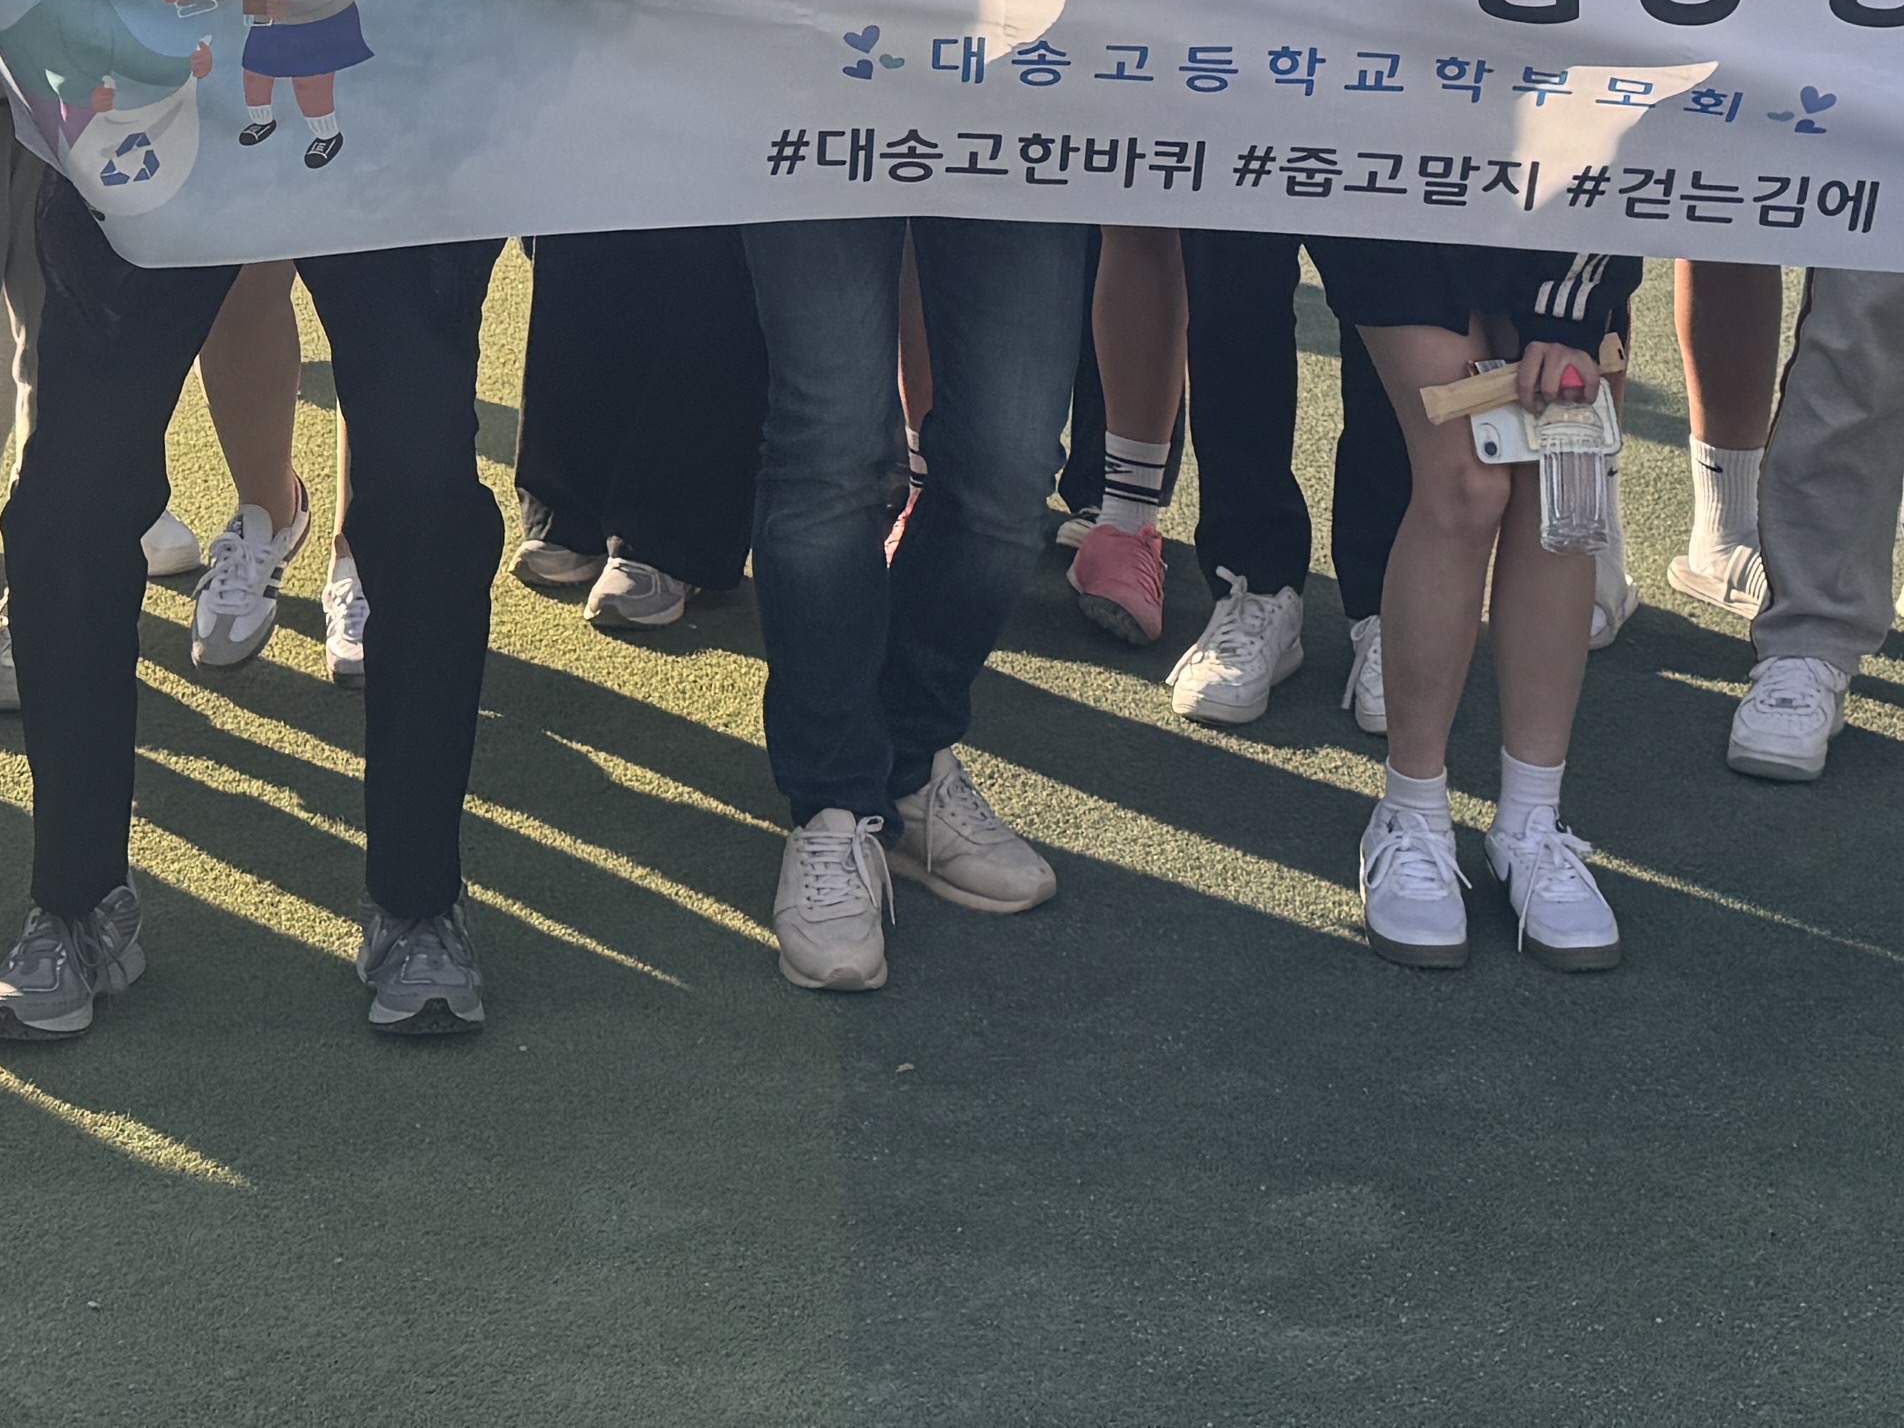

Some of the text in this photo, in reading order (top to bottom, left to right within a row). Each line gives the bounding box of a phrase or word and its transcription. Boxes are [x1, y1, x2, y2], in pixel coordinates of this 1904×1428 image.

[766, 127, 1880, 234] #대송고한바퀴 #줍고말지 #걷는김에
